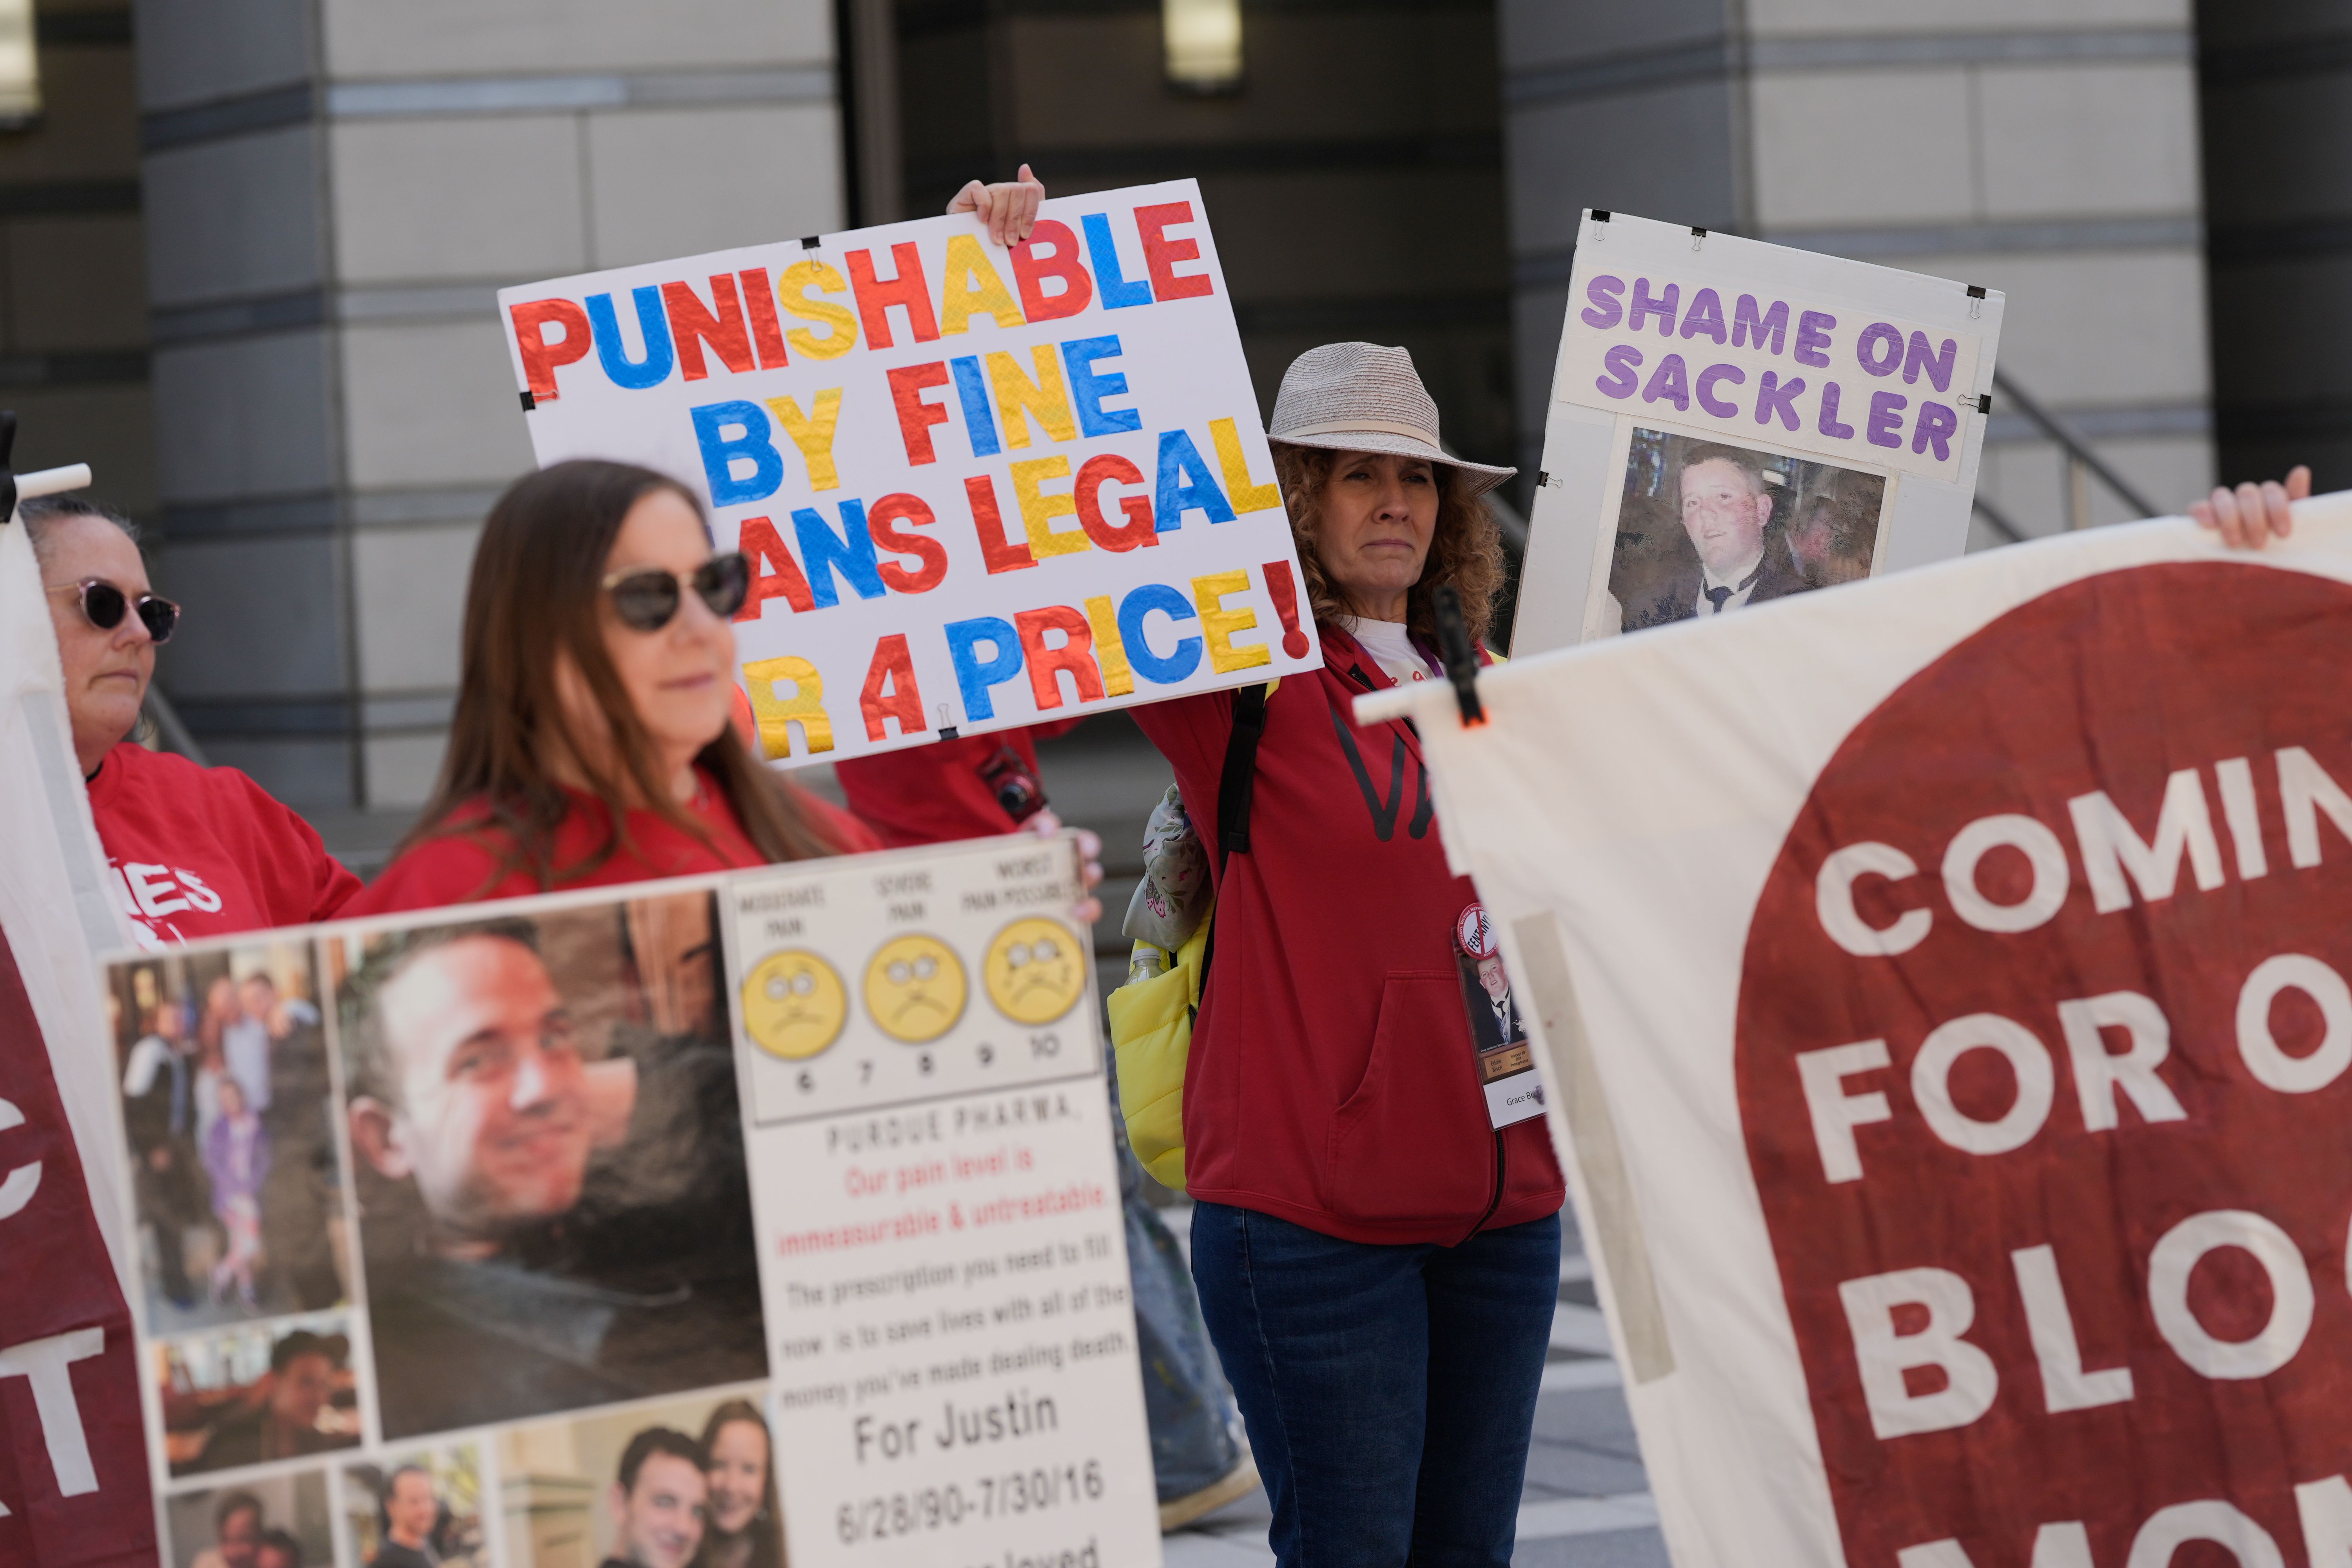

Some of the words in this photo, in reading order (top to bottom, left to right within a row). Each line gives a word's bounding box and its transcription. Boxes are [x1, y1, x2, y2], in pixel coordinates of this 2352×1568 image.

[510, 201, 1214, 403] PUNISHABLE
[1581, 274, 1837, 368] SHAME
[1857, 322, 1957, 392] ON
[690, 387, 842, 507] BY
[886, 334, 1142, 466] FINE
[1595, 345, 1958, 462] SACKLER
[707, 498, 948, 623] ANS
[964, 417, 1282, 575] LEGAL
[860, 633, 927, 742] A
[944, 560, 1309, 721] PRICE!
[1816, 746, 2352, 956] COMIN
[1460, 910, 1471, 924] VICTIMS
[796, 1071, 815, 1093] 6
[860, 1060, 873, 1083] 7
[918, 1053, 934, 1076] 8
[976, 1044, 993, 1067] 9
[1031, 1034, 1060, 1058] 10
[1507, 1096, 1525, 1106] Grace
[1796, 990, 2189, 1184] FOR
[827, 1111, 942, 1156] PURDUE
[845, 1164, 886, 1198] Our
[897, 1158, 943, 1194] pain
[951, 1147, 1009, 1181] level
[1014, 1146, 1033, 1170] is
[776, 1212, 940, 1257] immeasurable
[949, 1204, 965, 1231] &
[786, 1281, 823, 1308] The
[831, 1262, 956, 1307] prescription
[963, 1257, 998, 1292] you
[1006, 1243, 1053, 1274] need
[1060, 1241, 1079, 1265] to
[1083, 1234, 1112, 1259] fill
[782, 1336, 822, 1361] now
[836, 1327, 852, 1350] is
[861, 1323, 880, 1348] to
[886, 1318, 932, 1344] save
[941, 1304, 985, 1334] lives
[993, 1298, 1033, 1323] with
[1041, 1290, 1064, 1316] all
[1071, 1285, 1091, 1312] of
[1096, 1282, 1127, 1308] the
[1838, 1209, 2352, 1440] BLO
[782, 1377, 848, 1411] money
[855, 1365, 922, 1401] you've
[929, 1354, 982, 1383] made
[989, 1338, 1064, 1375] dealing
[853, 1415, 924, 1465] For
[935, 1390, 1058, 1451] Justin
[836, 1461, 1104, 1546] 6/28/90-7/30/16
